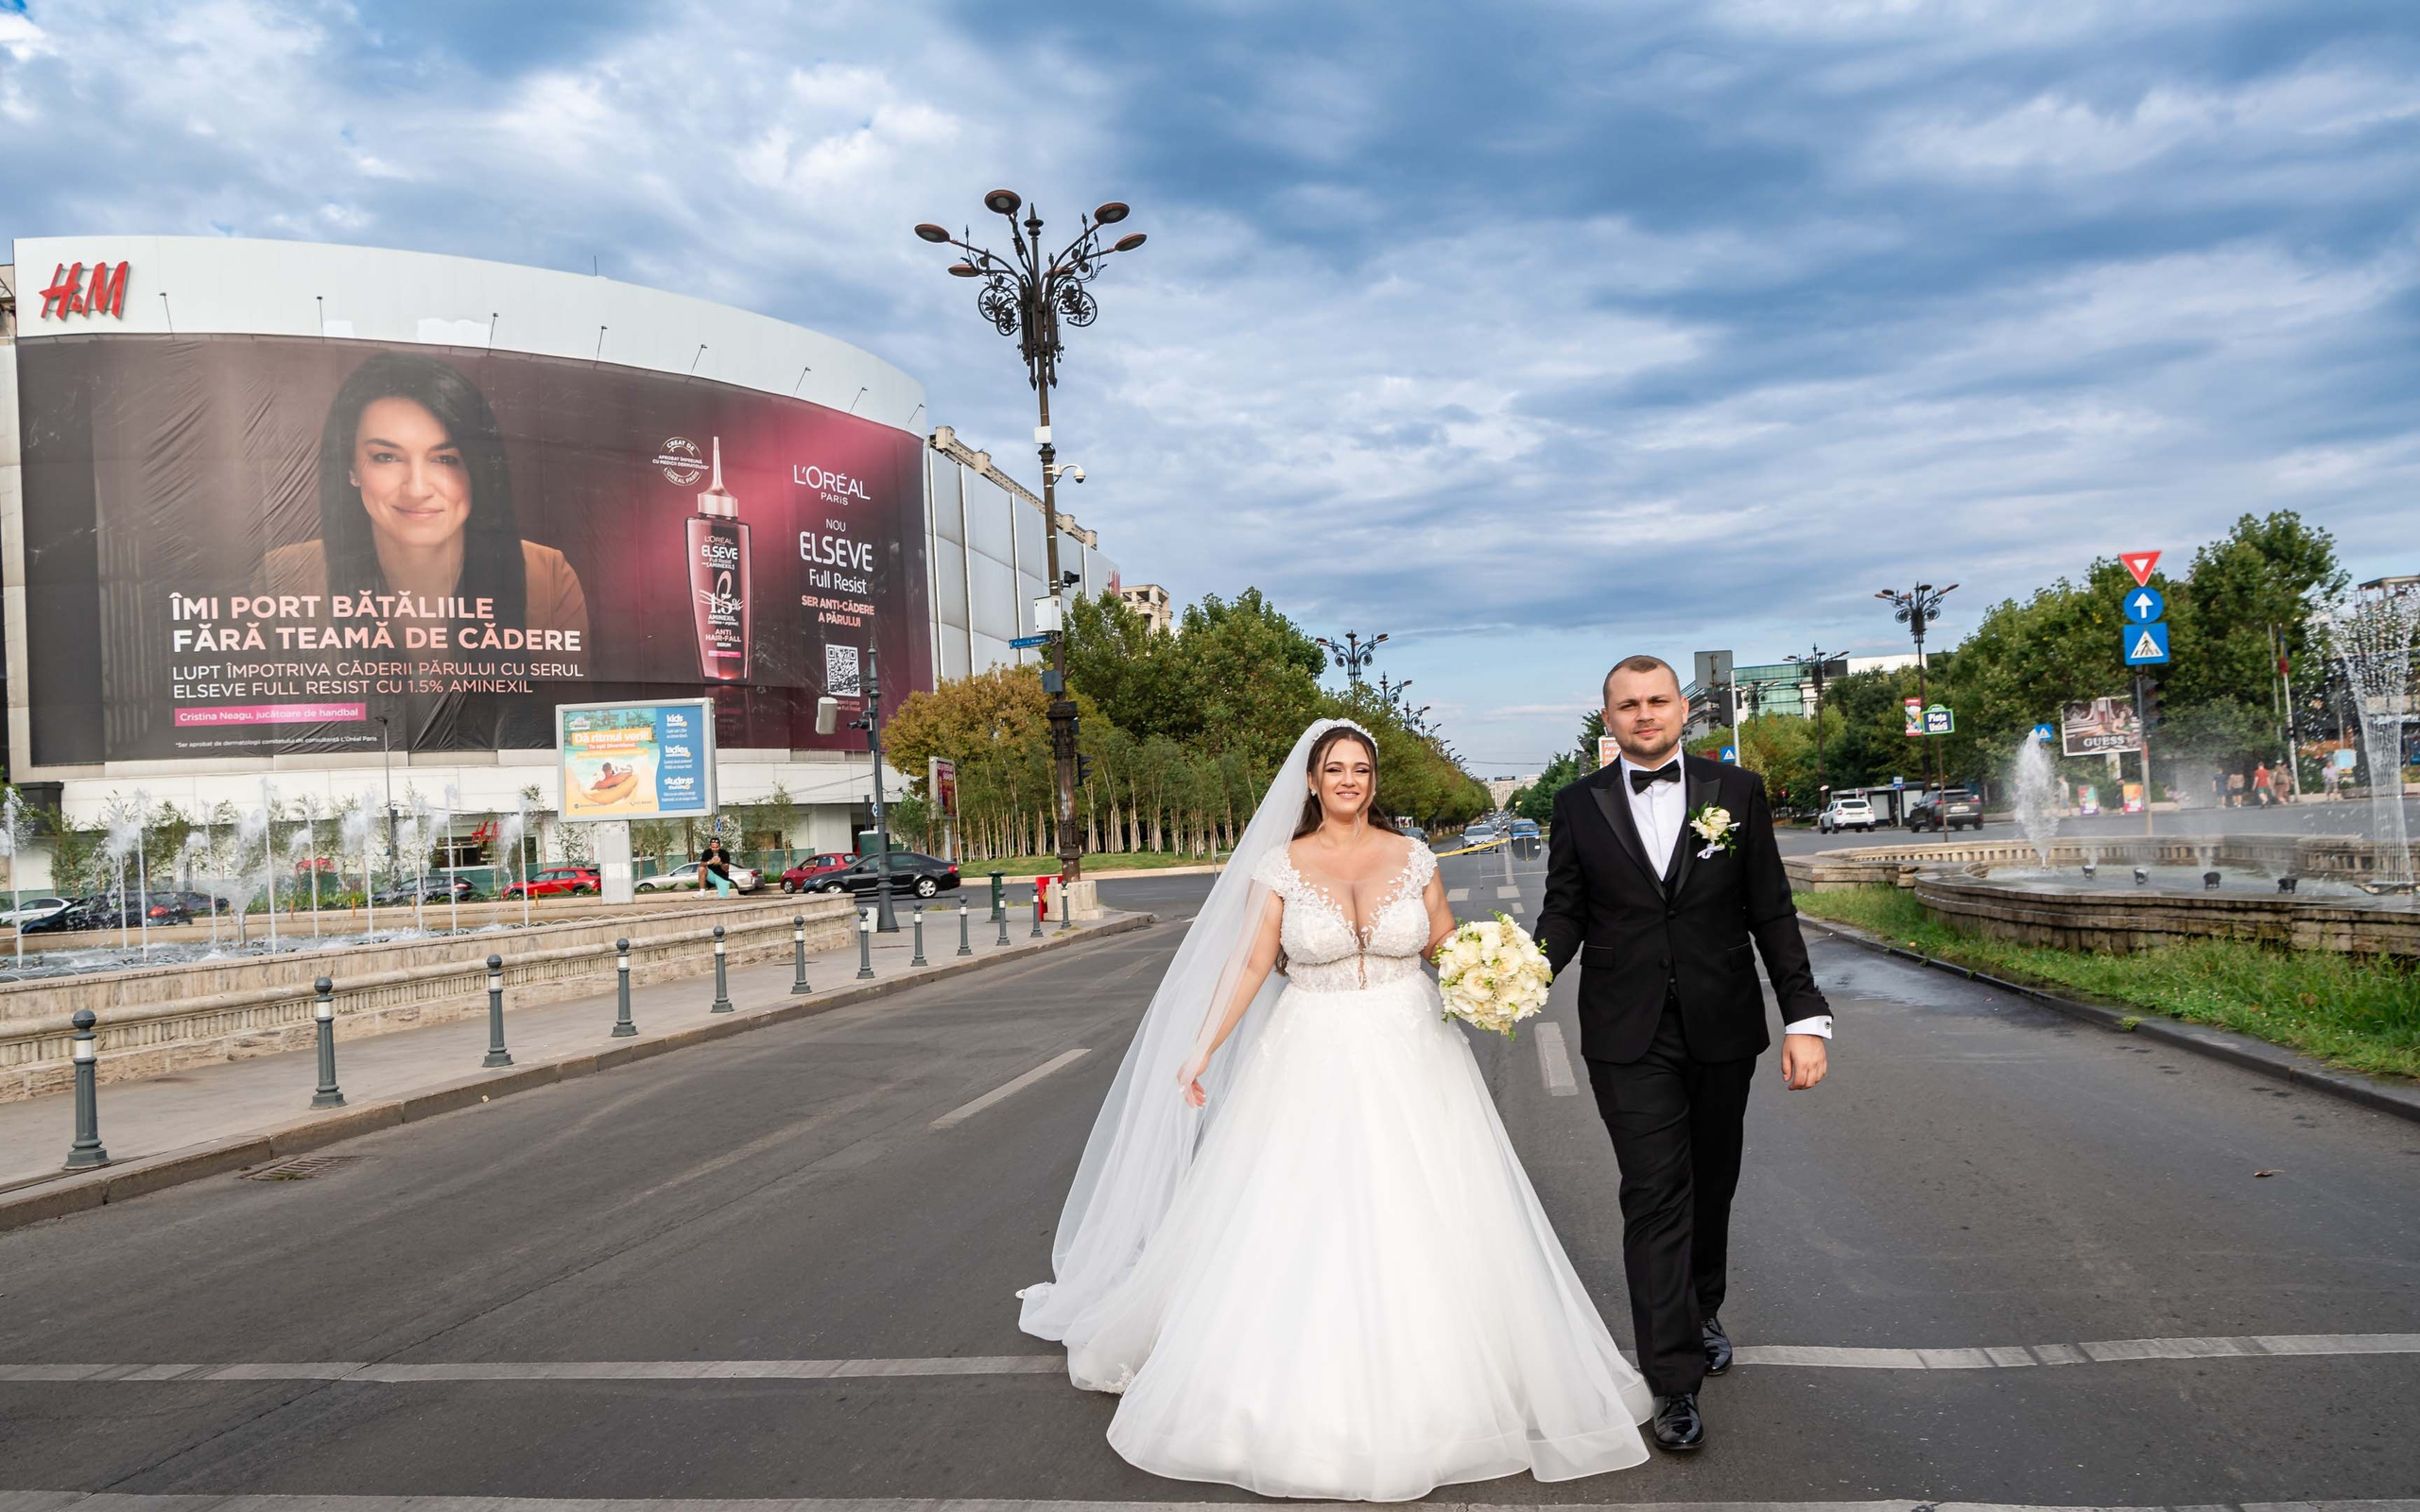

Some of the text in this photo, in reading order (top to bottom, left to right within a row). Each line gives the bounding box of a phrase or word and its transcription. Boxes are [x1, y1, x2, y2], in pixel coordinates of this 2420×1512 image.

[39, 261, 129, 320] H&M
[794, 464, 871, 500] L'ORÉAL
[825, 519, 846, 532] NOU
[701, 545, 738, 559] ELSEVE
[799, 531, 873, 572] ELSEVE
[809, 568, 867, 594] Full Resist
[169, 590, 493, 620] ÎMI PORT BĂTĂLIILE
[802, 595, 874, 615] SER ANTI-CĂDERE
[818, 611, 861, 627] A PĂRULUI
[173, 621, 581, 652] FĂRĂ TEAMĂ DE CĂDERE
[705, 634, 741, 643] HAIR-FALL
[173, 660, 583, 680] LUPT ÎMPOTRIVA CĂDERII PĂRULUI CU SERUL
[174, 679, 533, 698] ELSEVE FULL RESIST CU 1.5% AMINEXIL
[180, 708, 358, 721] Cristina Neagu, jucătoare de handbal
[575, 732, 590, 743] Dă
[591, 732, 622, 742] ritmul
[2083, 735, 2125, 747] GUESS
